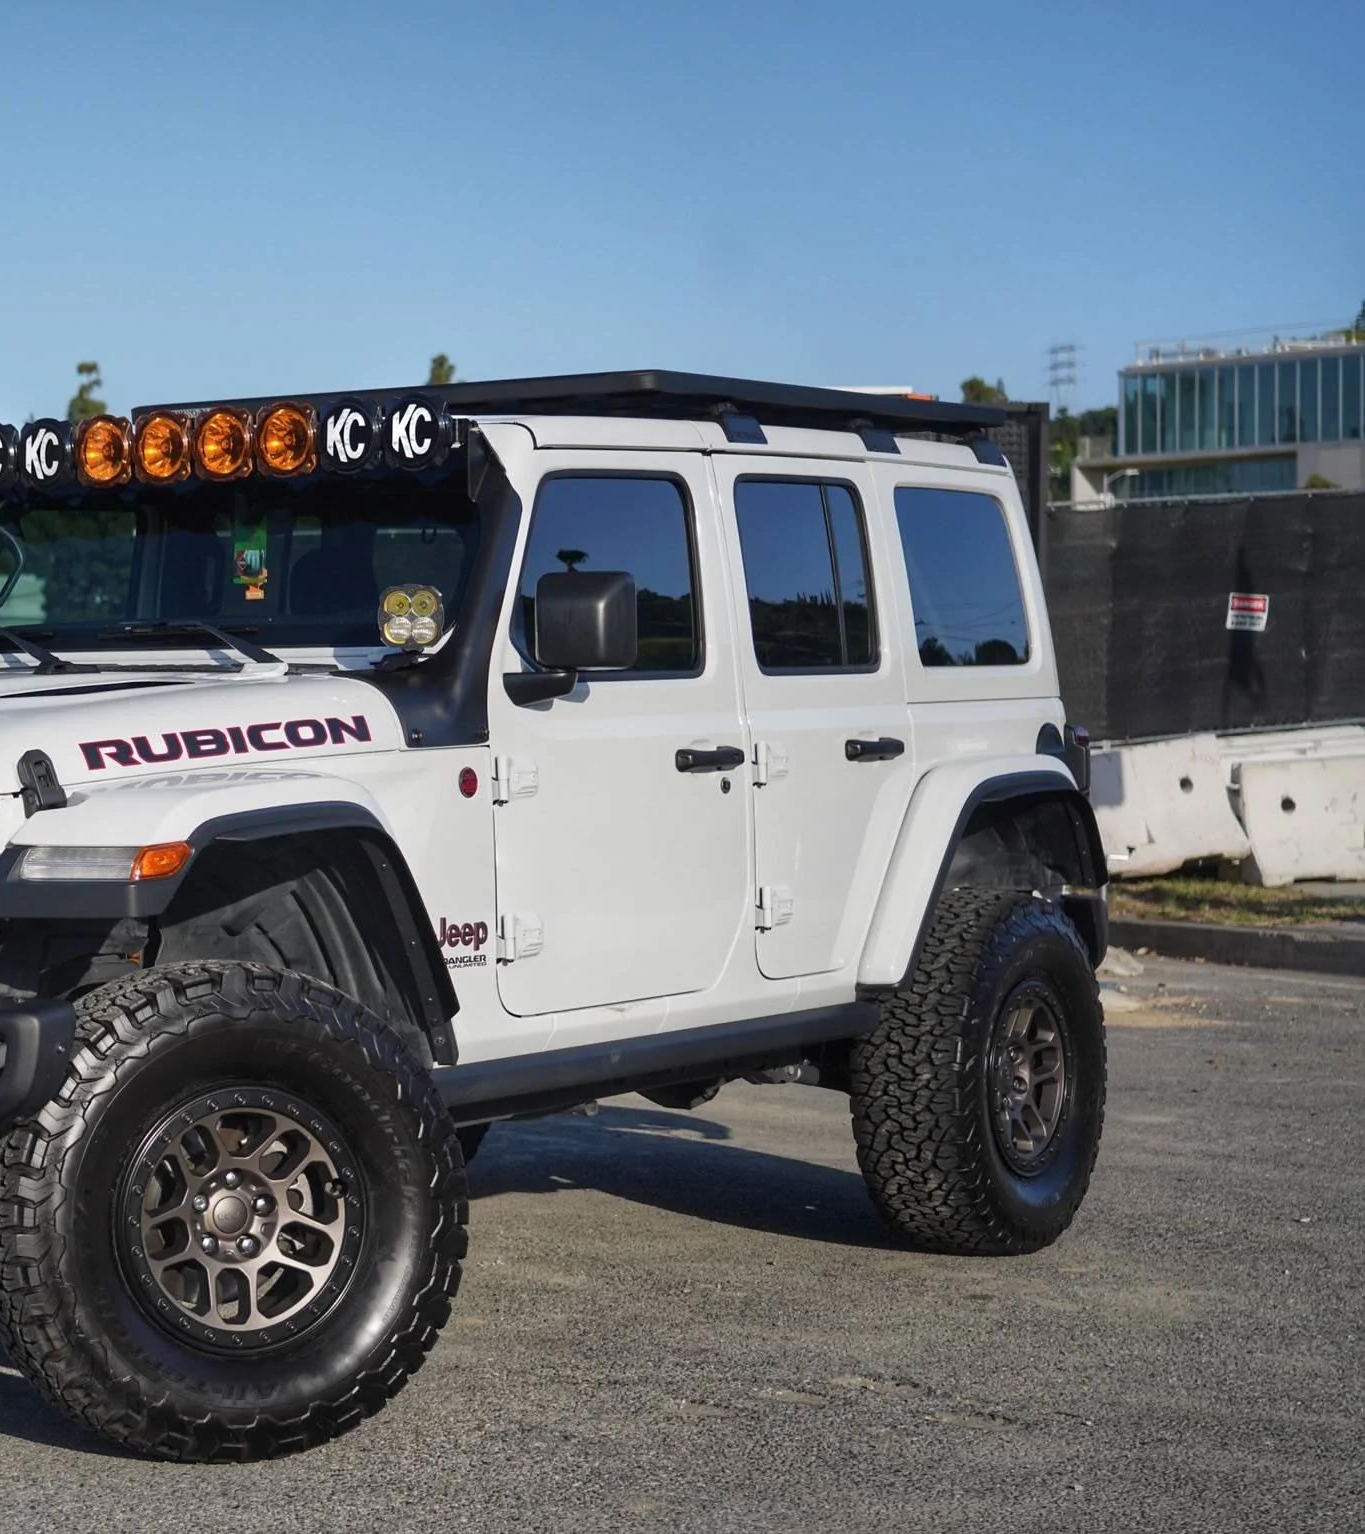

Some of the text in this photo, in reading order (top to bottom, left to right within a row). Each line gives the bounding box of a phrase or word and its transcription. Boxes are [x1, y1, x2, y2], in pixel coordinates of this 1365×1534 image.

[25, 428, 59, 480] KC
[326, 408, 366, 463] KC
[391, 403, 432, 458] KC
[78, 715, 372, 770] RUBICON
[439, 917, 488, 951] Jeep
[444, 954, 487, 966] RANGLER
